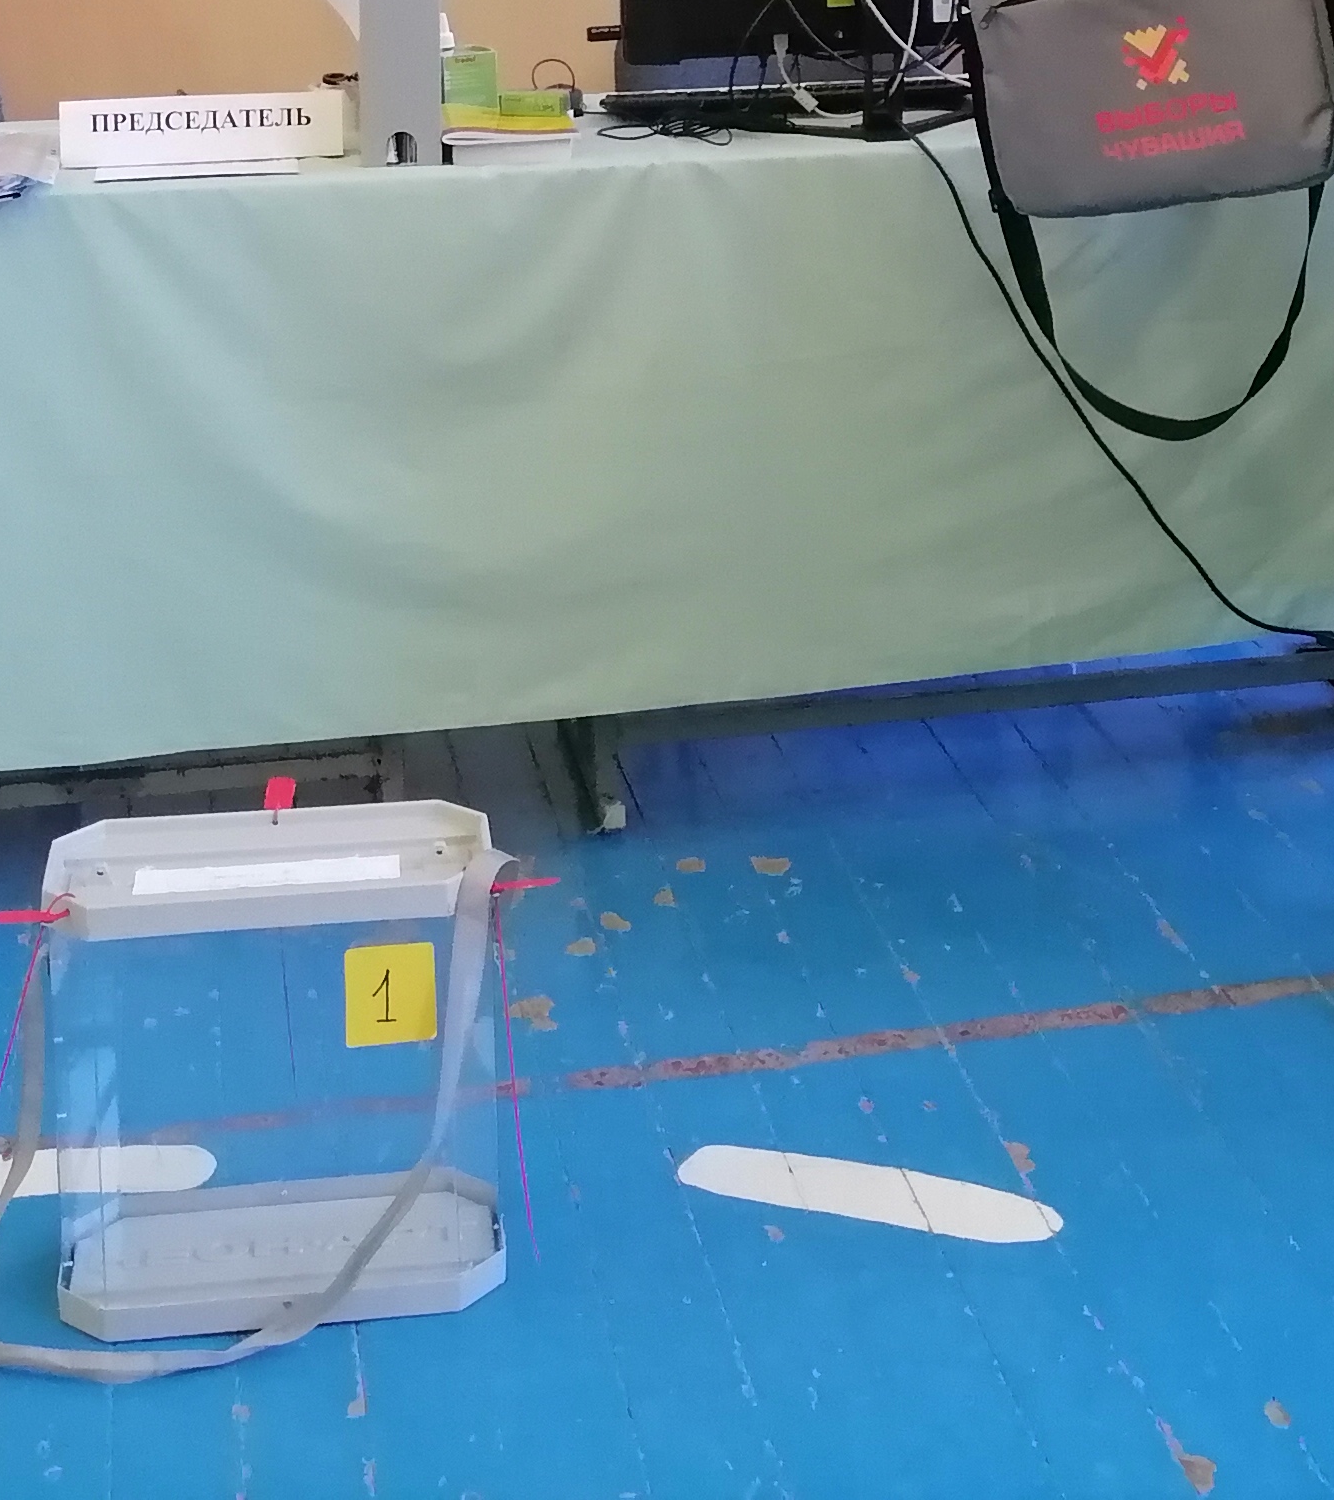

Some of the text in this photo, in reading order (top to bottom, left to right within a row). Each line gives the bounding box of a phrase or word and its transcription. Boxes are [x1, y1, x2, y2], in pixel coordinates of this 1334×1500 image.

[91, 107, 312, 135] ПРЕДСЕДАТЕЛЬ
[1095, 90, 1238, 133] ВЫБОРЫ
[1102, 120, 1246, 161] ЧУВАШИЯ
[372, 968, 397, 1023] 1
